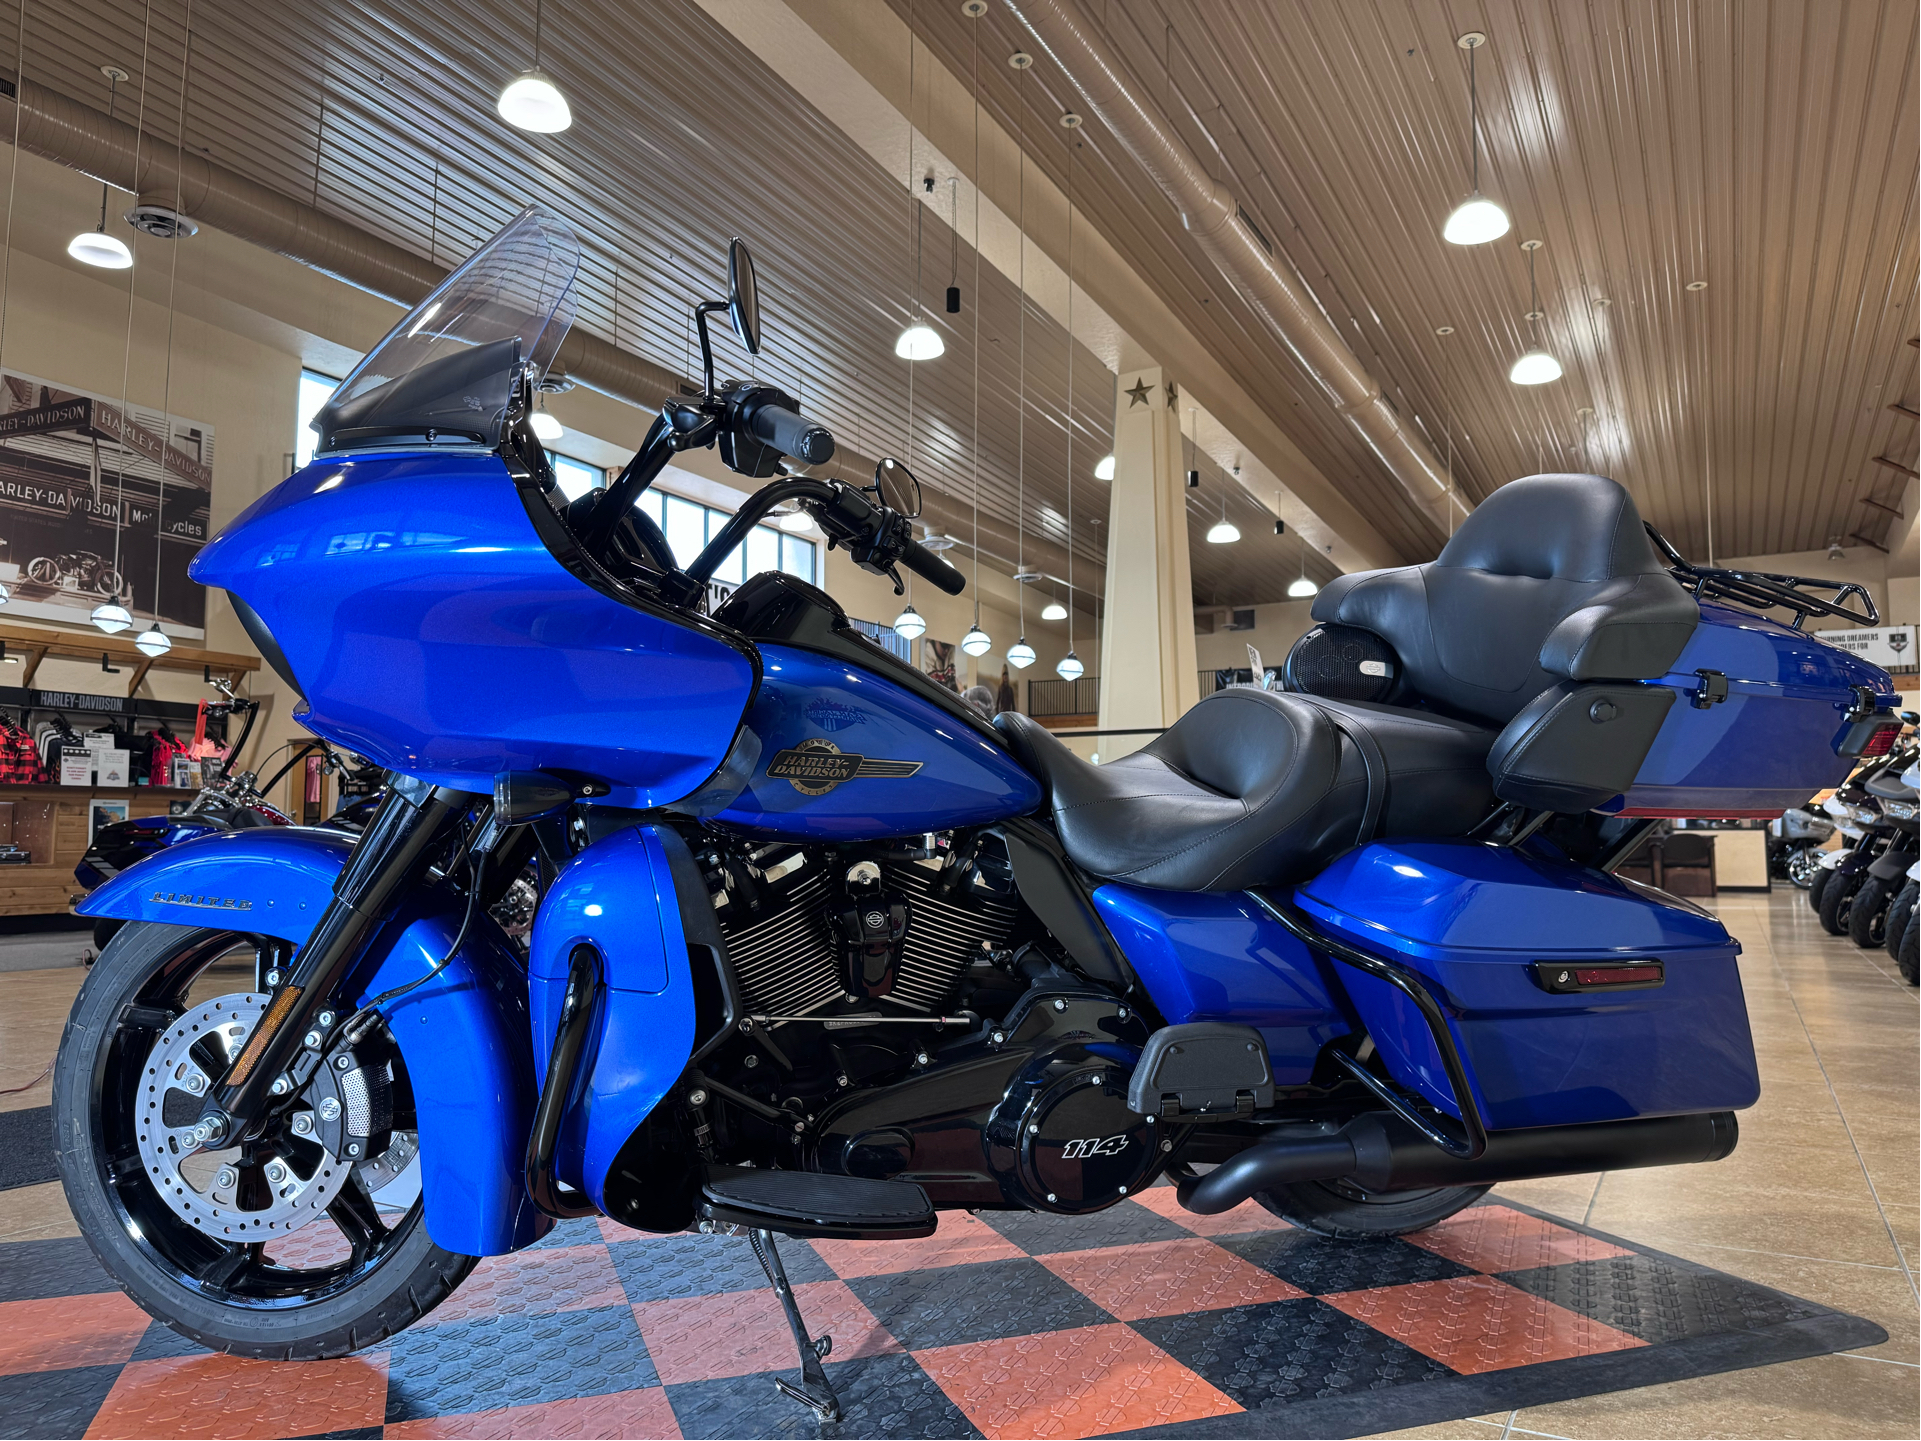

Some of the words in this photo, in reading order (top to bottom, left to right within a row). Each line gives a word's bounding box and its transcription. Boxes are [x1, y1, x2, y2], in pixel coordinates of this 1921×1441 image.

[101, 410, 211, 482] HARLEY-DAVIDSON
[40, 691, 123, 712] HARLEY-DAVIDSON
[773, 765, 850, 778] DAVIDSON
[151, 891, 252, 910] LIMITED
[1061, 1134, 1129, 1159] 114
